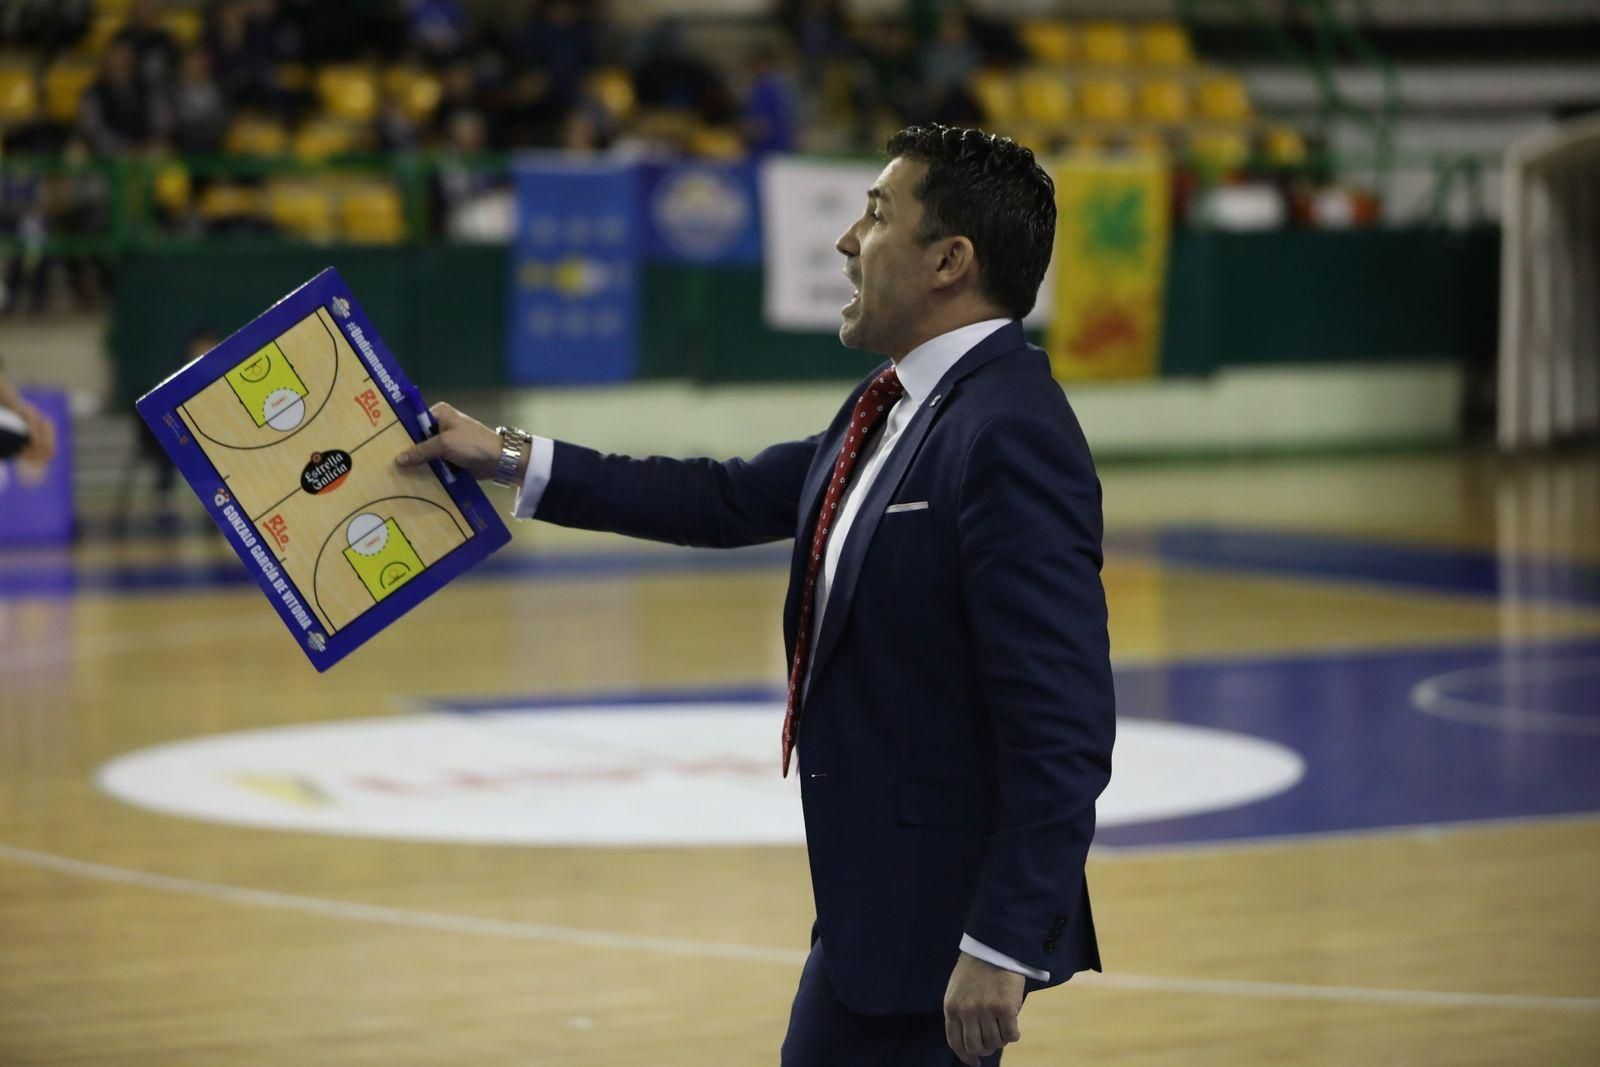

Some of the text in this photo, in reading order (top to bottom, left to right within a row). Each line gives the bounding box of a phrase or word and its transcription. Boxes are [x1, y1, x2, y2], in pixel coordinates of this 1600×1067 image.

[304, 453, 344, 483] Estrella
[312, 463, 348, 490] Galicia
[223, 504, 313, 630] GONZALO GARCÍA DE VITORIA
